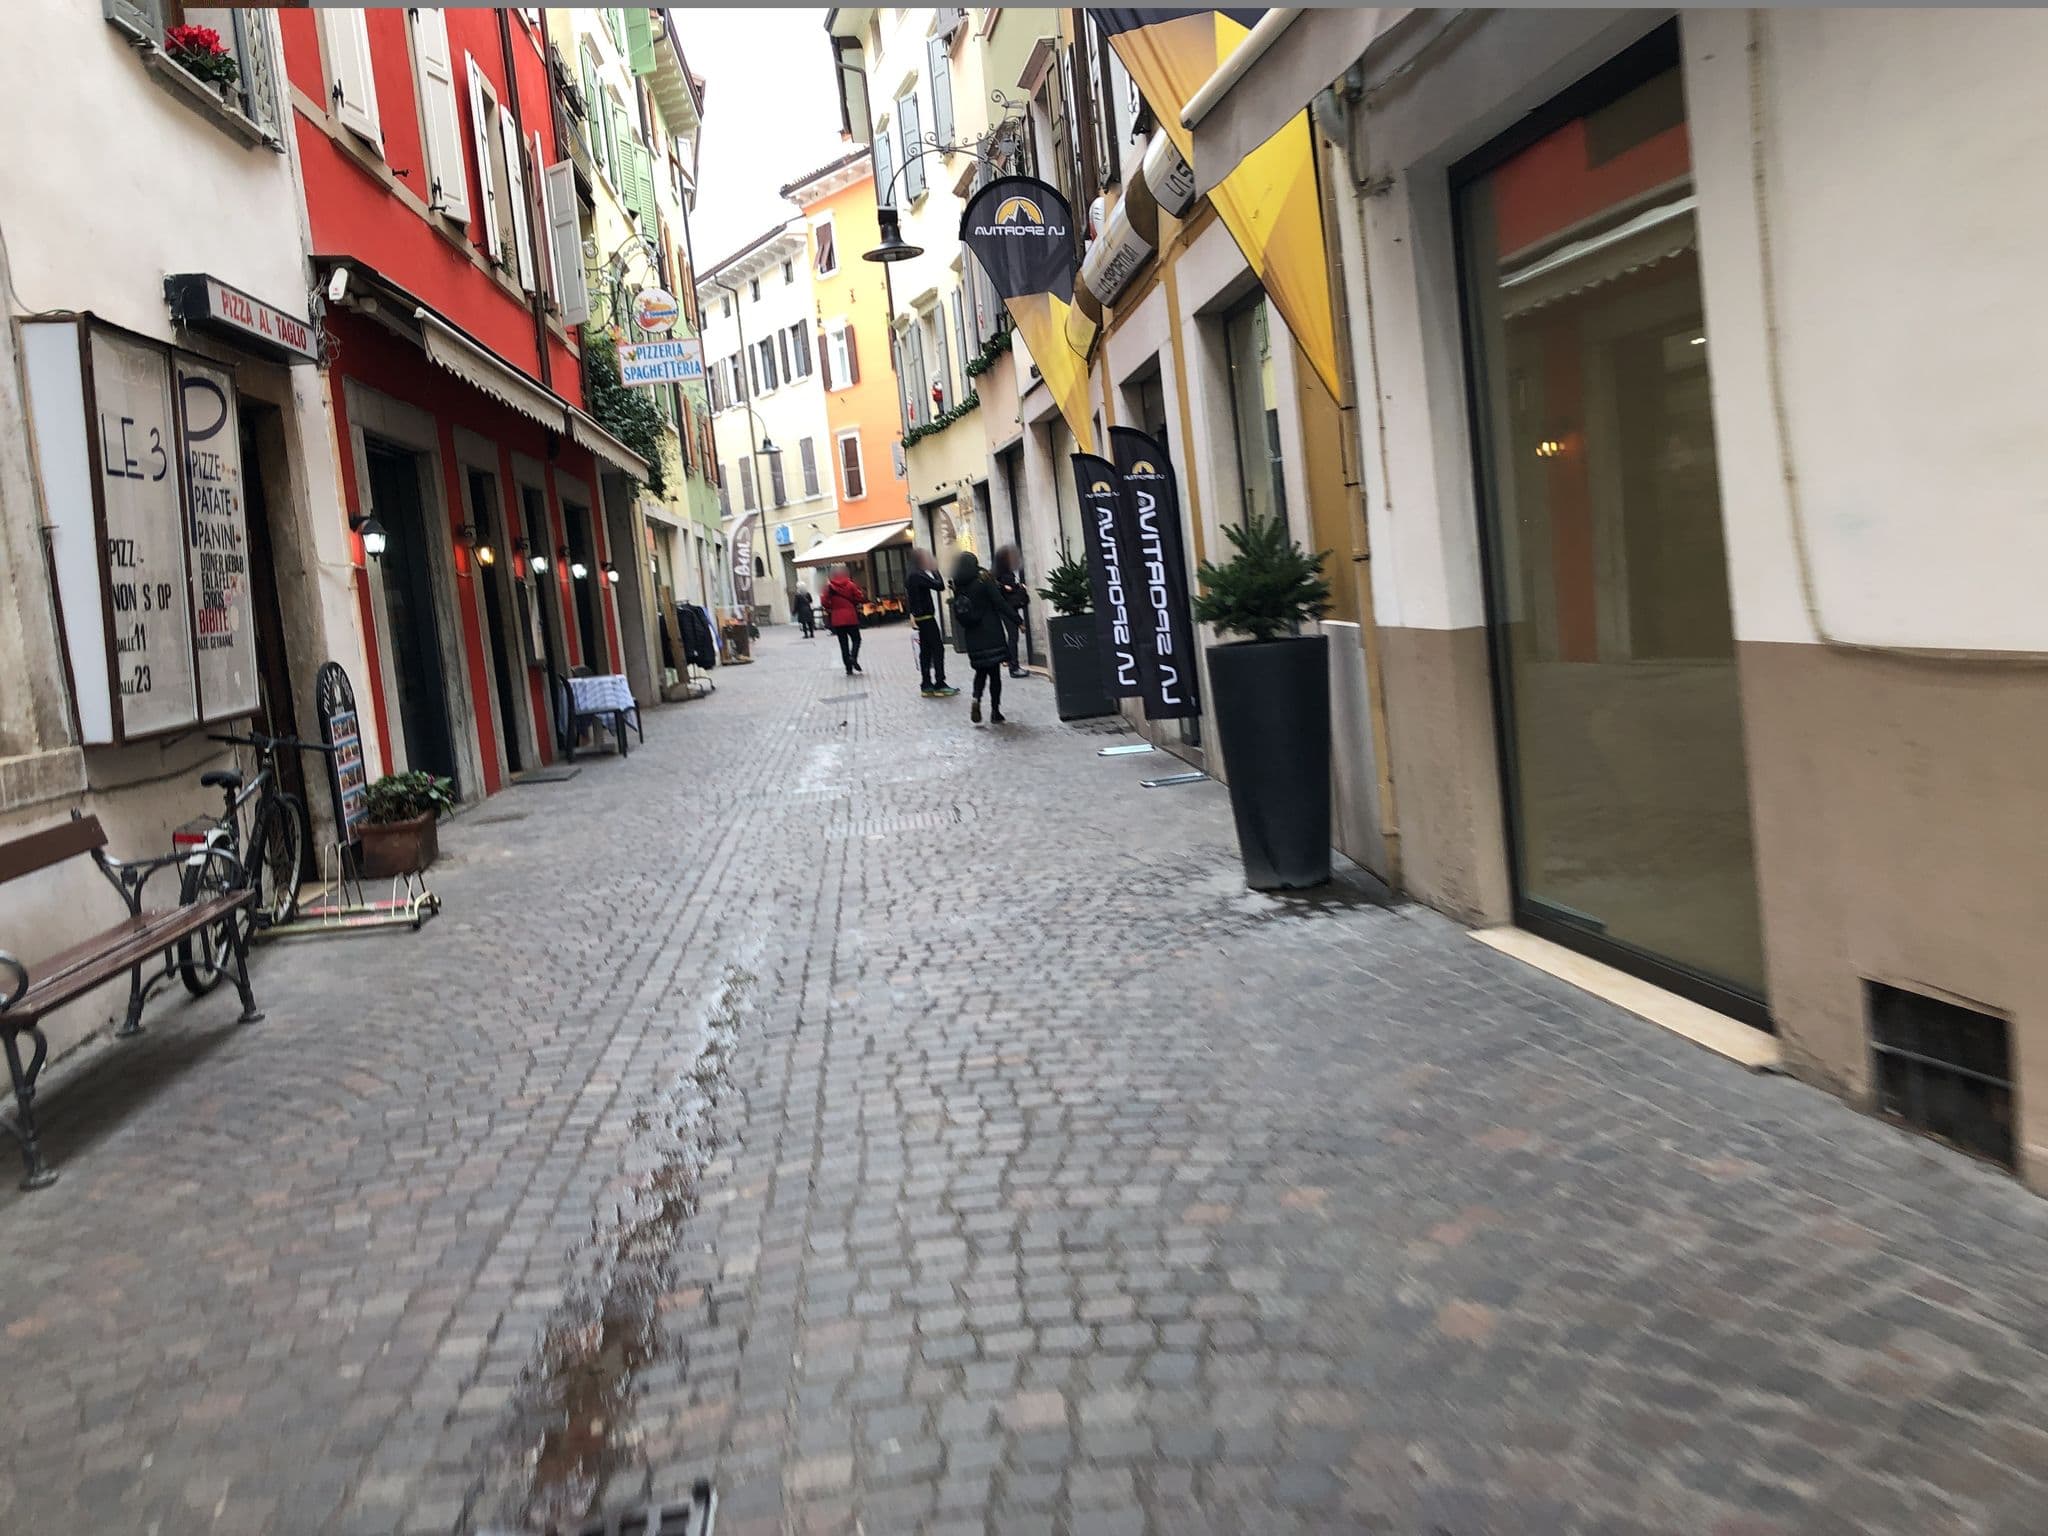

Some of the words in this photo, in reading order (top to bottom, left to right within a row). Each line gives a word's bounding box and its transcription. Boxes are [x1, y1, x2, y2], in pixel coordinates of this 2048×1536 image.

[221, 287, 254, 328] PIZZA
[259, 308, 272, 335] AL
[275, 315, 306, 351] TAGLIO
[636, 343, 684, 360] PIZZERIA
[624, 361, 702, 381] SPAGHETTERIA
[101, 413, 144, 480] LE
[150, 427, 167, 481] 3
[191, 450, 221, 481] PIZZE
[194, 486, 231, 516] PATATE
[198, 522, 236, 549] PANINI
[112, 583, 137, 612] NON
[199, 608, 229, 634] BIBITE
[134, 623, 146, 651] 11
[134, 665, 151, 693] 23
